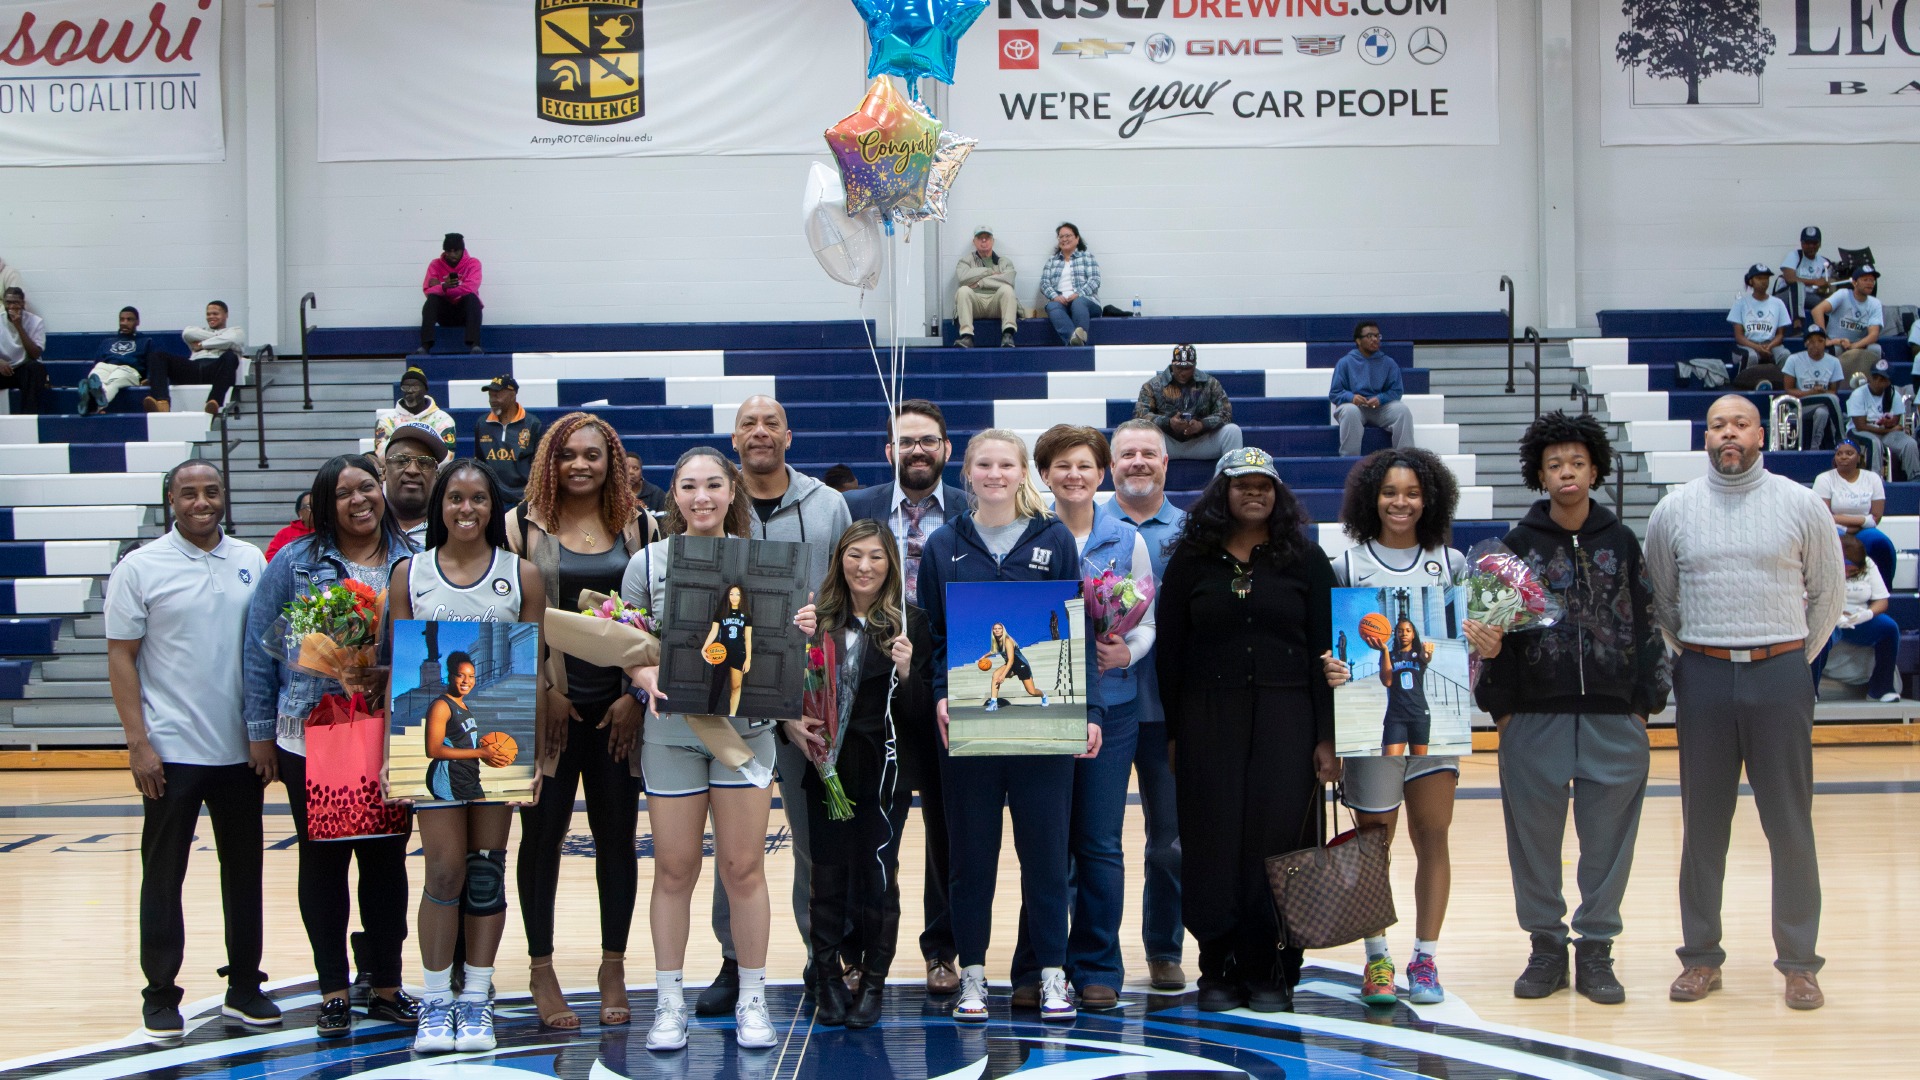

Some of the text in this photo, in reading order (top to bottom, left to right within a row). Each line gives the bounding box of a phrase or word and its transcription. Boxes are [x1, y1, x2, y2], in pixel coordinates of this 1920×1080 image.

[1362, 27, 1392, 39] BMW
[1185, 38, 1284, 57] GMC
[49, 80, 197, 113] COALITION
[545, 97, 638, 120] EXCELLENCE
[999, 79, 1449, 139] WE'RE your CAR PEOPLE
[530, 133, 653, 146] ArmyROTC@lincolnu.edu
[858, 127, 938, 174] Congrats!
[729, 626, 738, 639] 3
